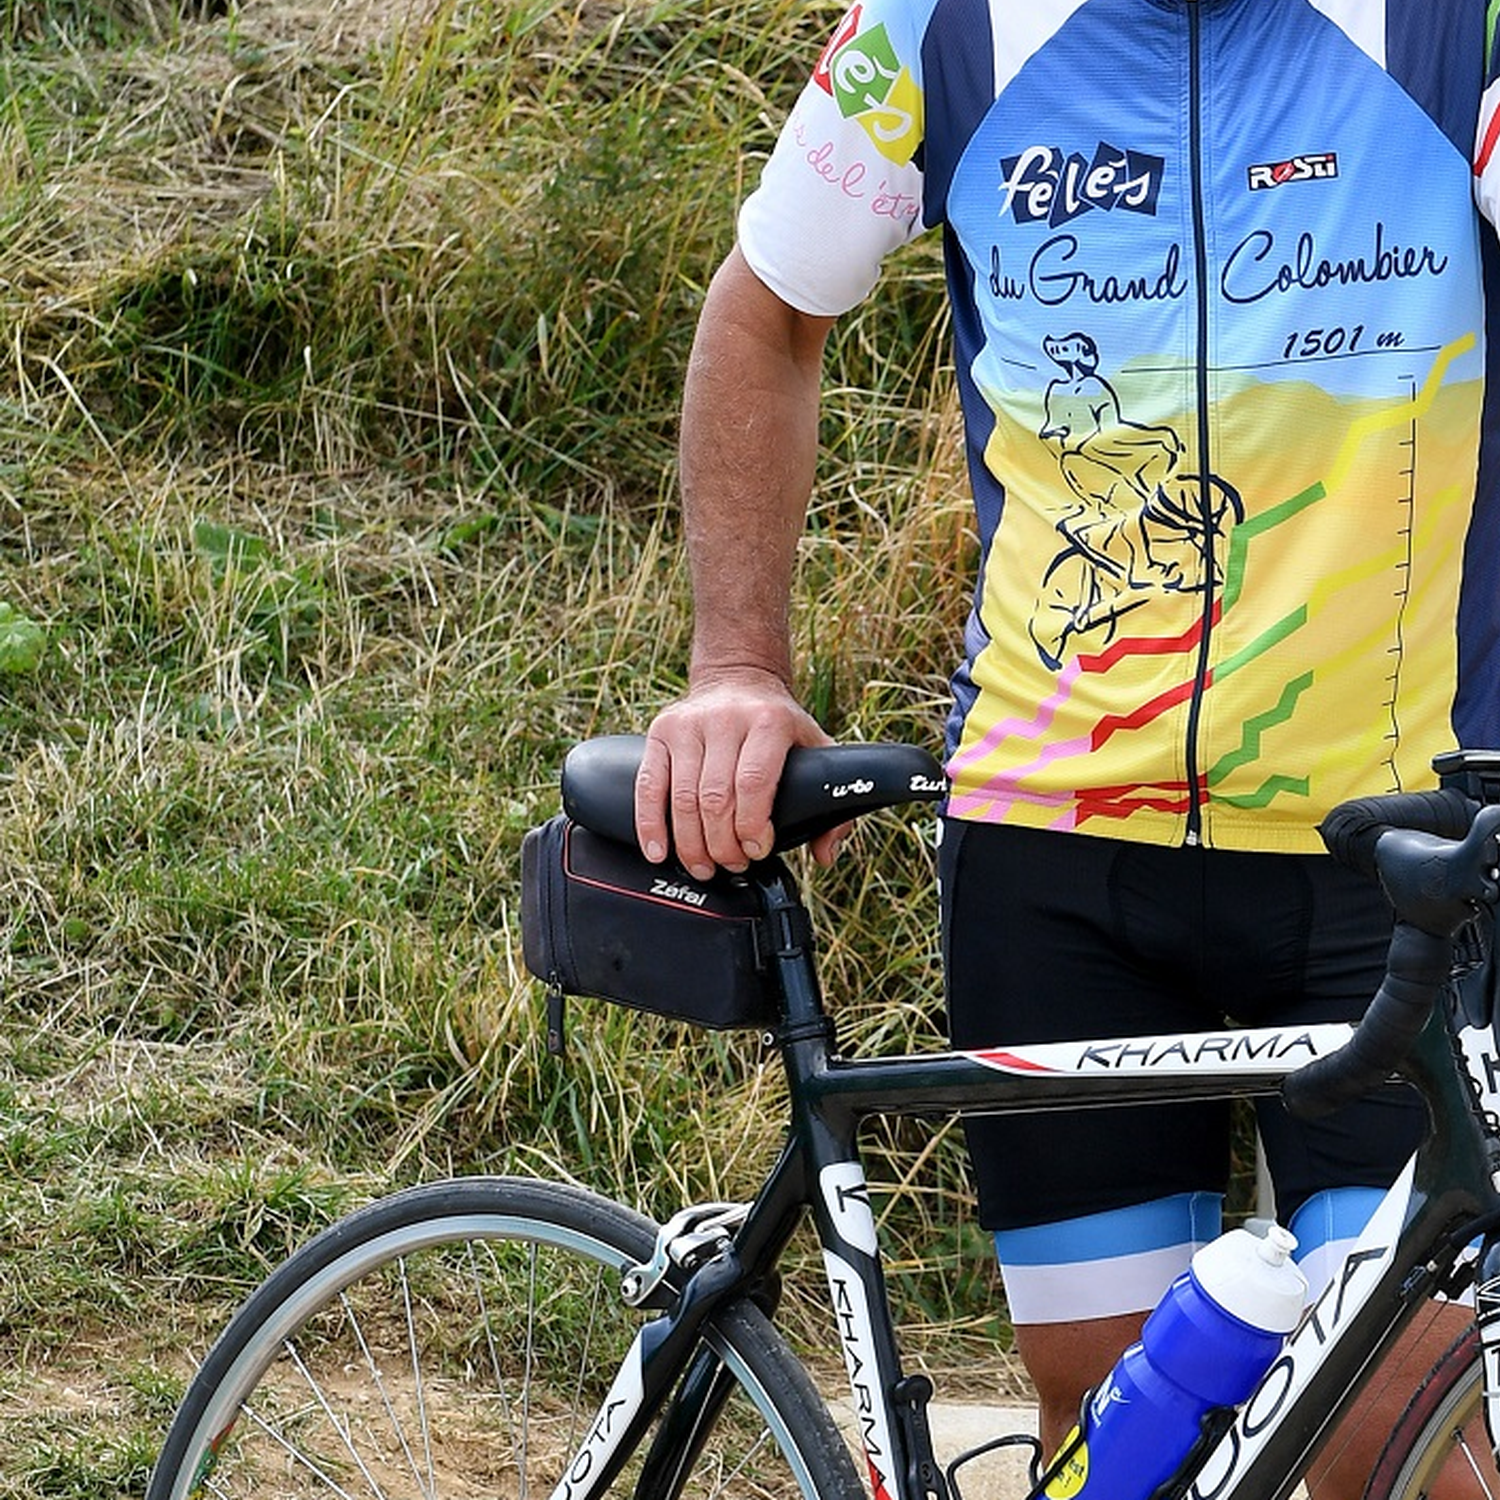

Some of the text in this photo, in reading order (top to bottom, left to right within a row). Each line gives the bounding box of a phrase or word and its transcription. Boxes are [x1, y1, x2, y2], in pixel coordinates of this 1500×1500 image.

[989, 221, 1449, 306] du Grand Colombier
[1283, 324, 1405, 359] 1501 m
[1075, 1031, 1320, 1071] KHARMA
[831, 1278, 888, 1489] KHARMA
